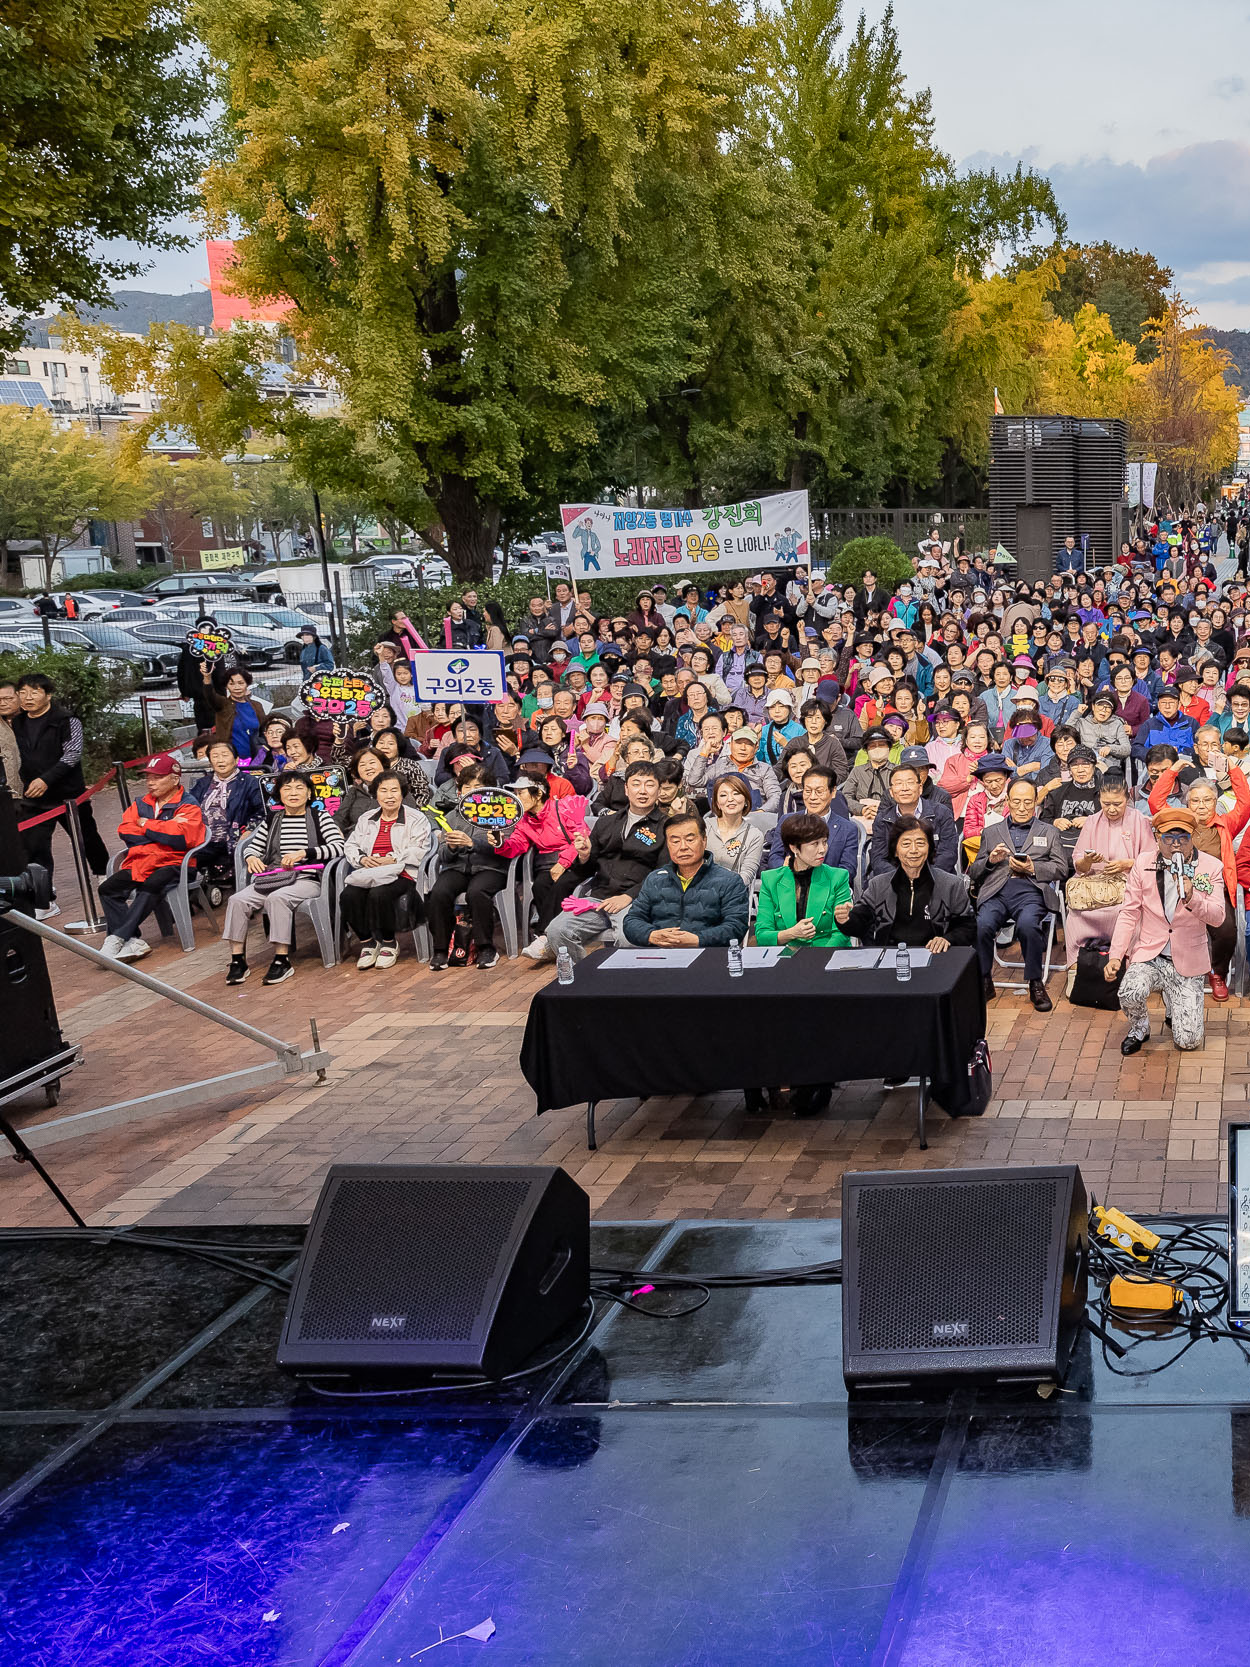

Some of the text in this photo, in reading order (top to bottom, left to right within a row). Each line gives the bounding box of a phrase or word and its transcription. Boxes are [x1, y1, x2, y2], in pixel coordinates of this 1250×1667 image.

[613, 500, 762, 531] 자양2동 명가수 강진희
[613, 532, 771, 567] 노래자랑 우승 은 나야나!
[322, 675, 365, 688] 슈퍼스타
[425, 677, 496, 697] 구의2동
[312, 698, 372, 717] 구의2동
[463, 803, 518, 819] 구의2동
[477, 817, 506, 826] 파이팅
[371, 1316, 406, 1329] NEXT
[933, 1321, 968, 1336] NEXT
